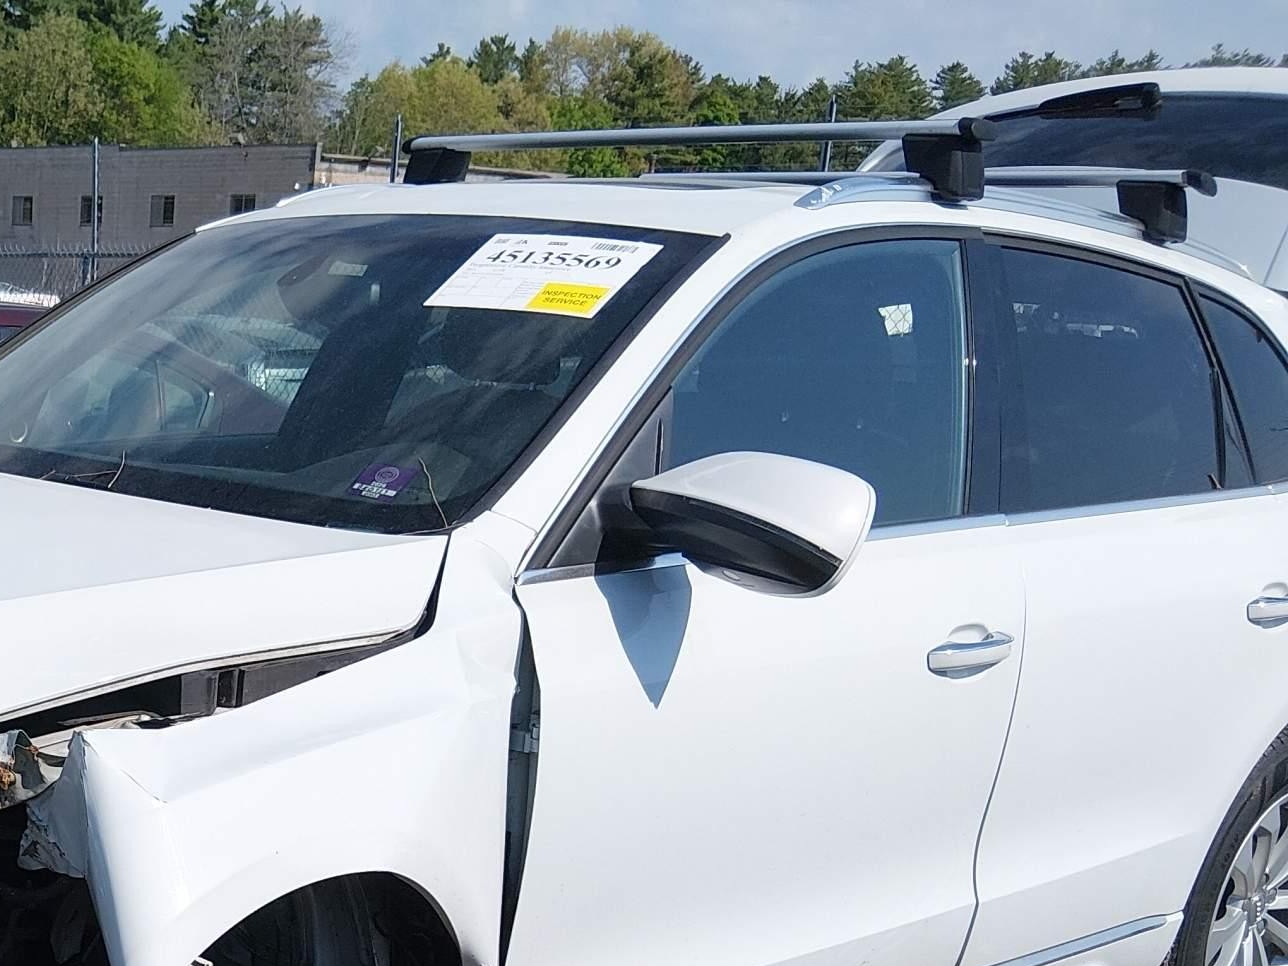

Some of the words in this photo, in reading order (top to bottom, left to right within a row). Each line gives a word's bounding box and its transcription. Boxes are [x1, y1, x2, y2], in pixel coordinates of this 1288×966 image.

[487, 249, 622, 270] 45135569
[542, 289, 602, 300] INSPECTION
[542, 297, 587, 306] SERVICE
